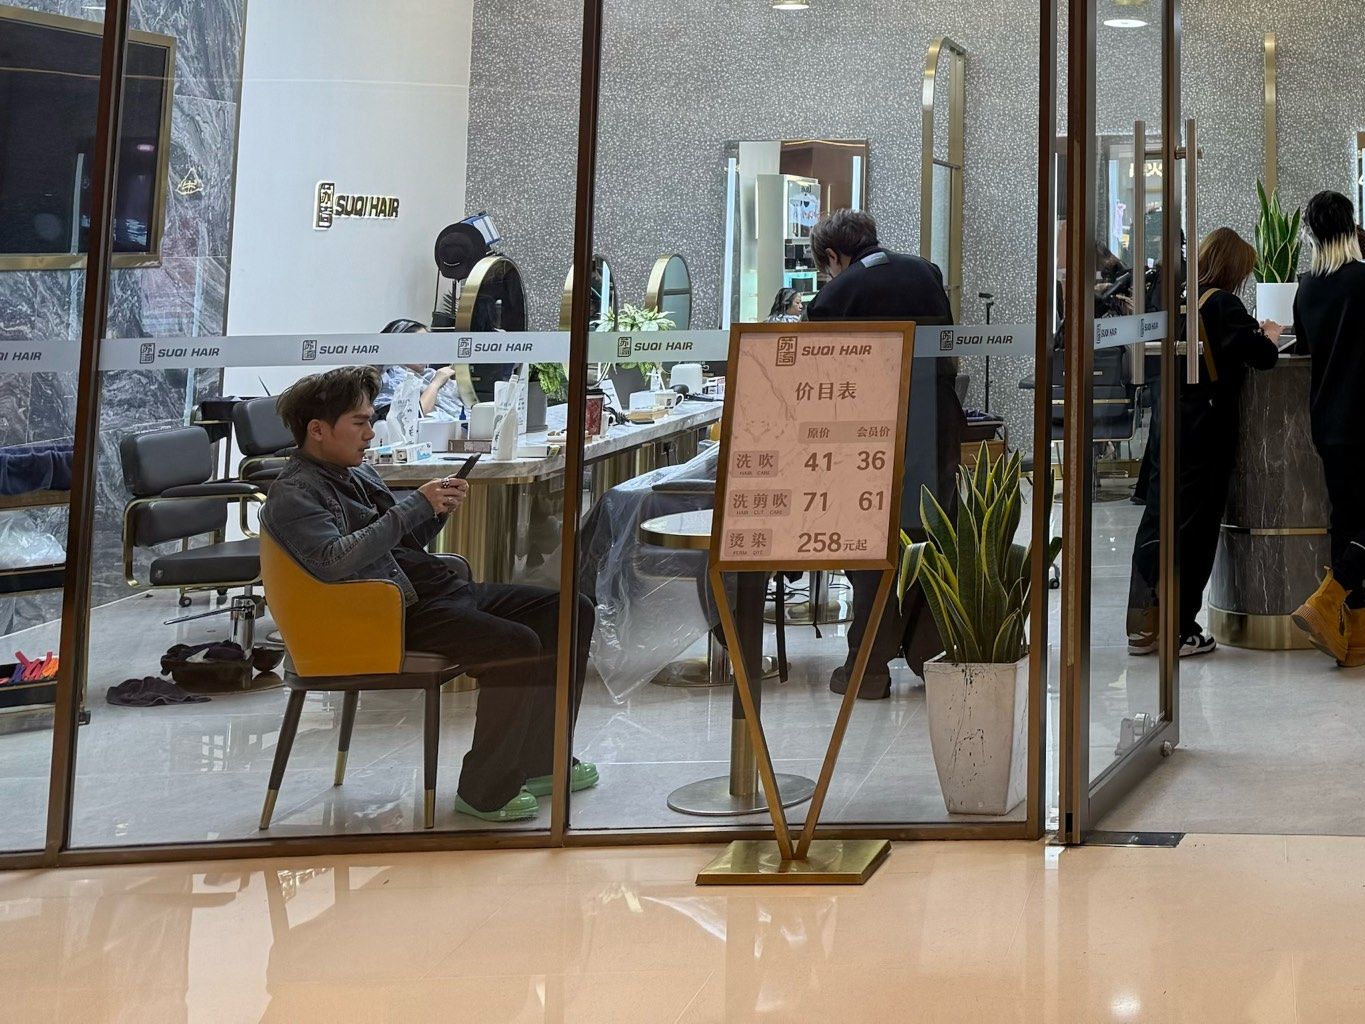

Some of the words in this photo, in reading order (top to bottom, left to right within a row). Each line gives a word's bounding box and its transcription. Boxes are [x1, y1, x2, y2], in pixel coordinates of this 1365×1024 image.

[335, 195, 369, 217] SUQI
[369, 196, 400, 218] HAIR
[956, 335, 982, 345] SUQI
[986, 335, 1013, 344] HAIR
[319, 344, 346, 355] SUQI
[352, 344, 380, 354] HAIR
[474, 343, 502, 352] SUQI
[506, 342, 533, 352] HAIR
[634, 342, 662, 352] SUQI
[666, 341, 693, 351] HAIR
[801, 345, 835, 356] SUQI
[839, 345, 872, 355] HAIR
[12, 352, 42, 361] HAIR
[157, 348, 188, 358] SUQI
[190, 347, 220, 357] HAIR
[795, 381, 857, 401] 价目表
[807, 427, 830, 439] 原价
[856, 426, 891, 438] 会员价
[736, 453, 774, 469] 洗吹
[804, 451, 833, 472] 41
[856, 450, 886, 471] 36
[733, 493, 788, 509] 洗剪吹
[803, 491, 829, 512] 71
[858, 490, 884, 511] 61
[729, 531, 767, 548] 烫染
